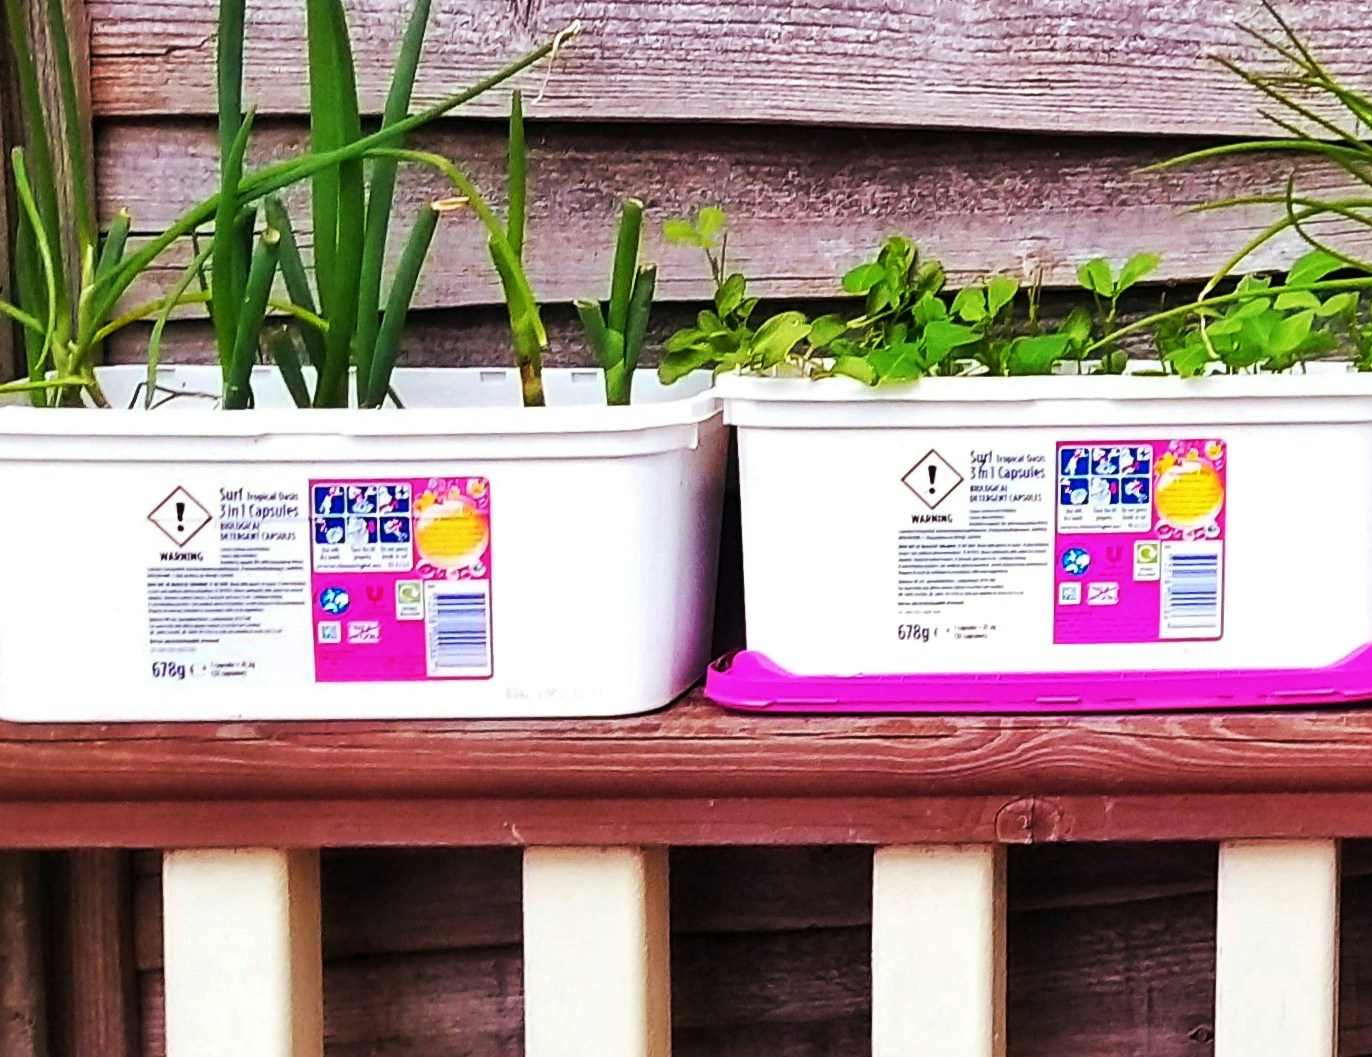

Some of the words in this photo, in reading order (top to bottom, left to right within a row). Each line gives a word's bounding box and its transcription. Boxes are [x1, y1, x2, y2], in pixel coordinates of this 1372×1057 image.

[970, 450, 993, 464] Surf
[998, 465, 1046, 481] Capsules
[220, 487, 244, 502] Surf
[249, 504, 299, 520] Capsules
[911, 514, 953, 524] WARNING
[160, 552, 204, 562] WARNING
[898, 624, 930, 642] 678g
[152, 661, 186, 680] 678g
